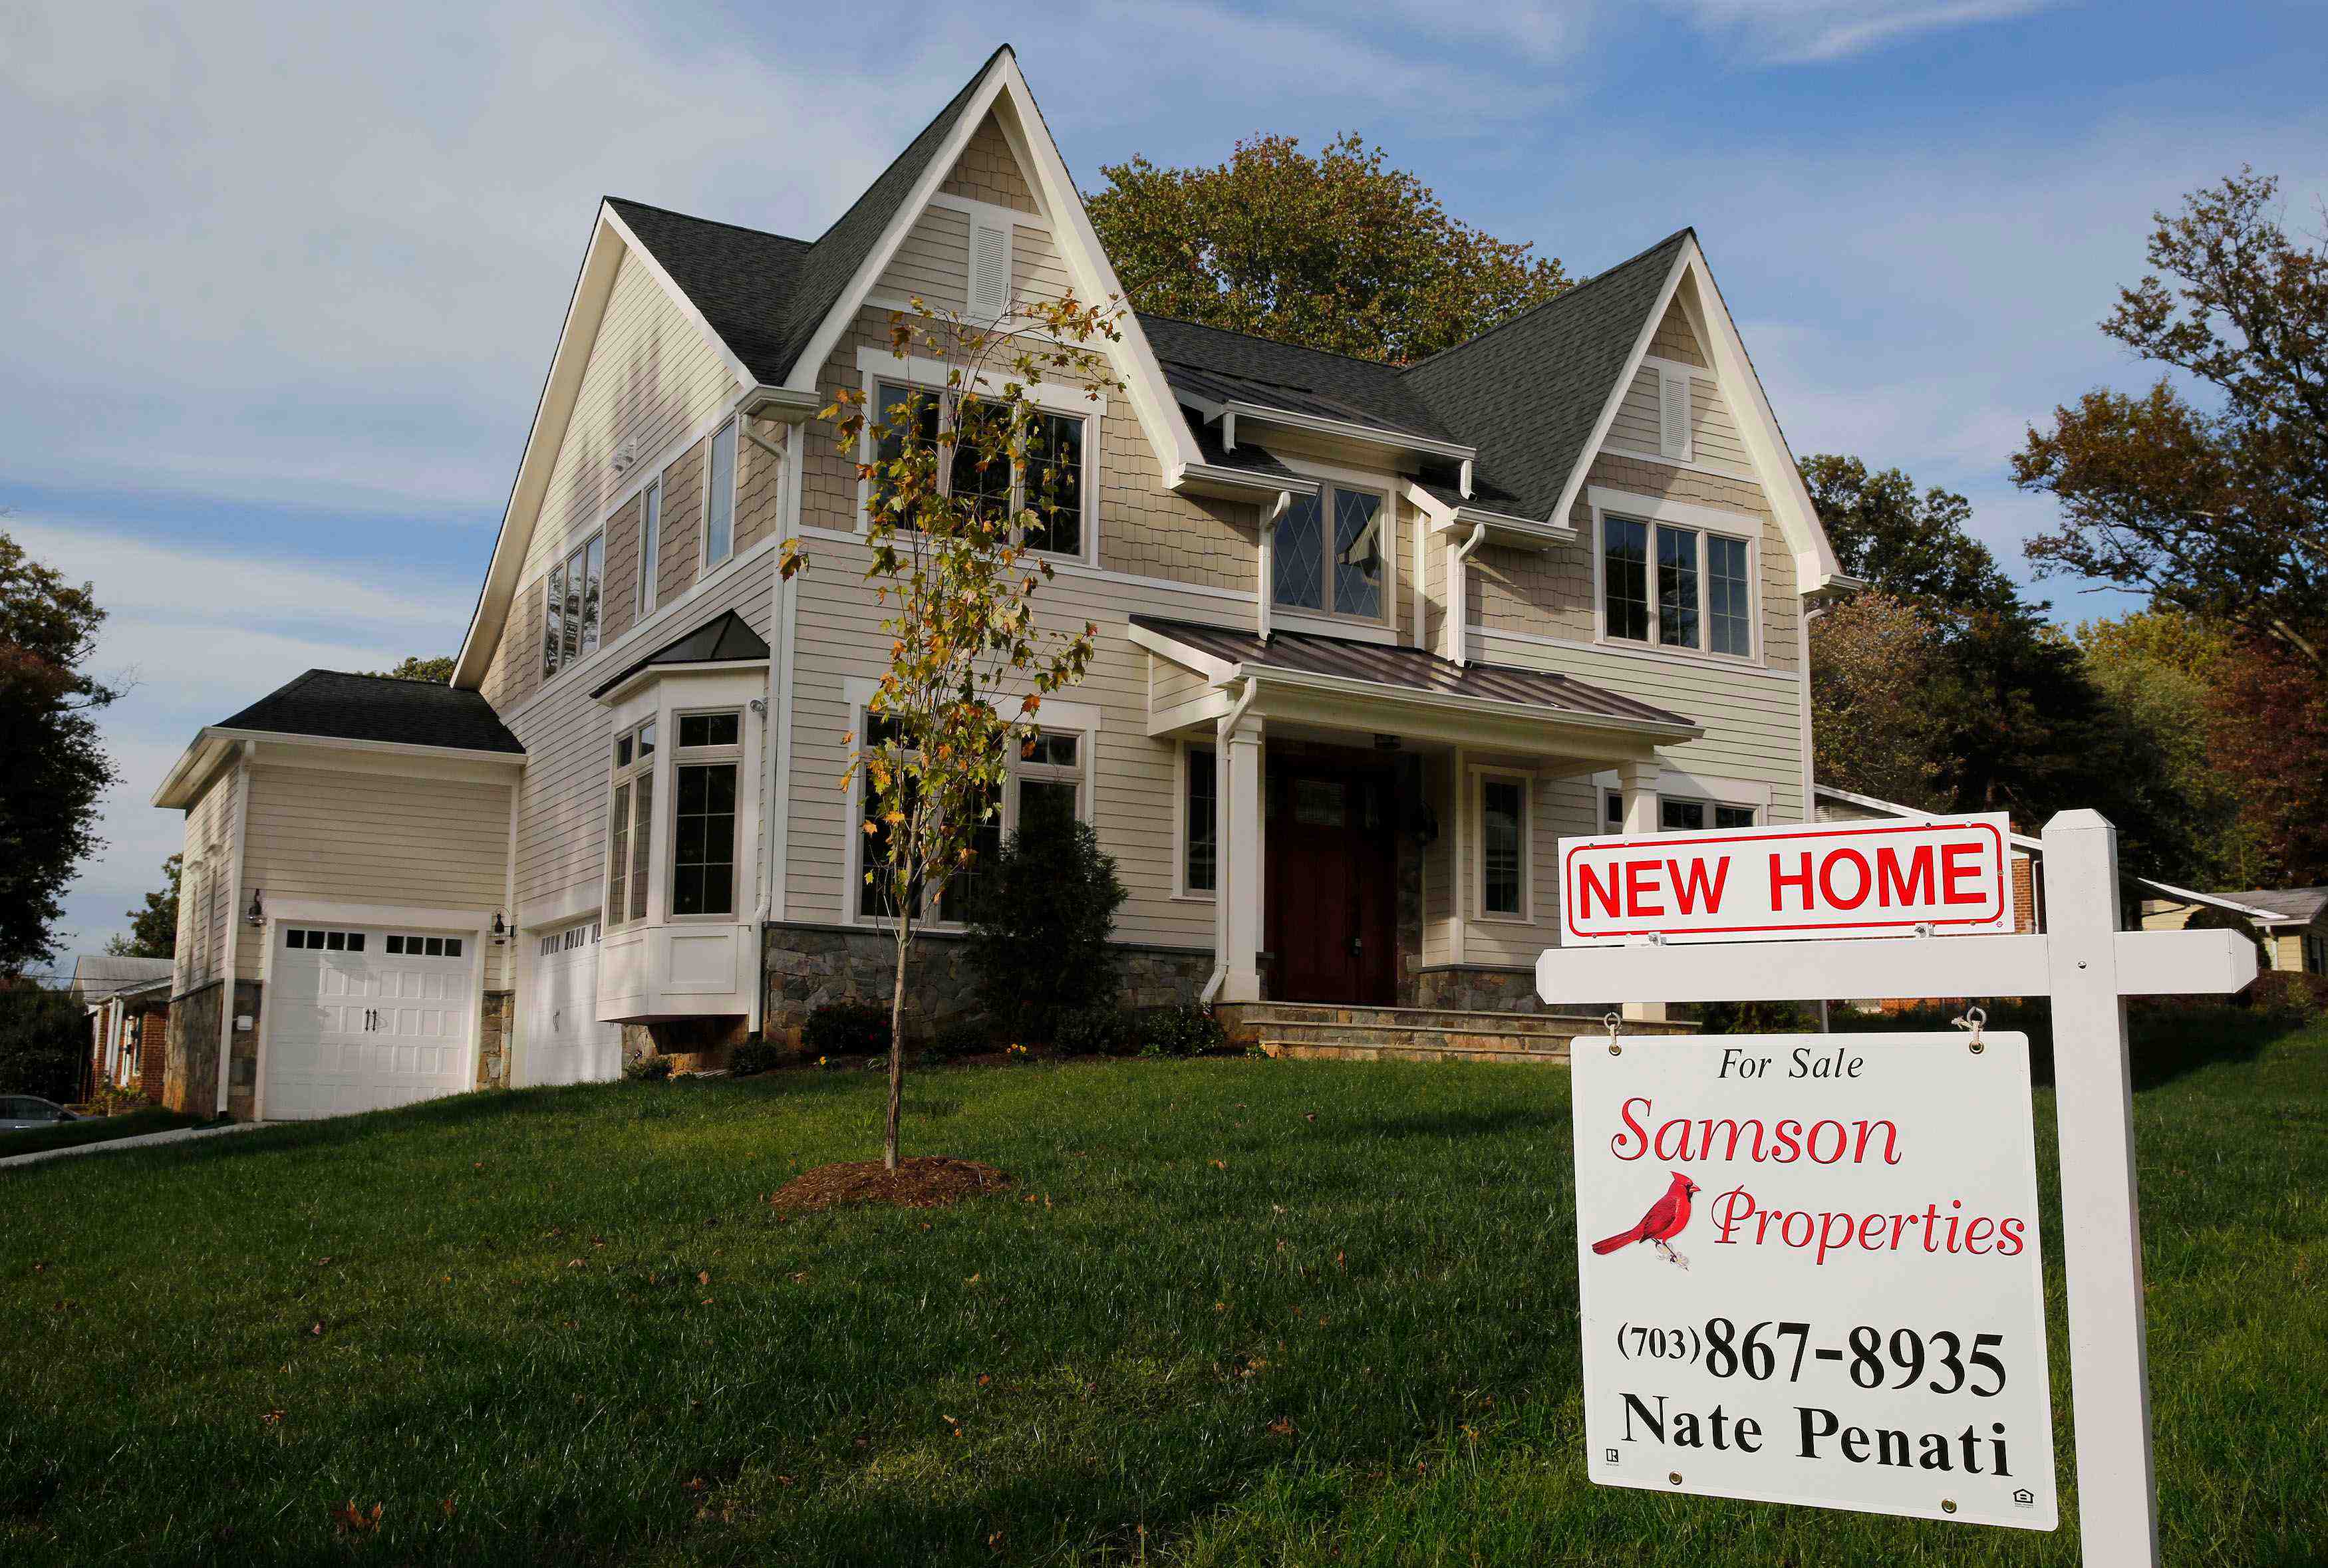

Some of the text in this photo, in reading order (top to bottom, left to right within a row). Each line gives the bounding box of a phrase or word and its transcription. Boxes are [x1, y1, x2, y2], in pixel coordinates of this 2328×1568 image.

[1578, 842, 1987, 920] NEW HOME
[1717, 1047, 1864, 1079] For Sale
[1611, 1097, 1902, 1165] Samson
[1711, 1184, 2026, 1265] Properties
[1618, 1392, 2014, 1478] Nate Penati
